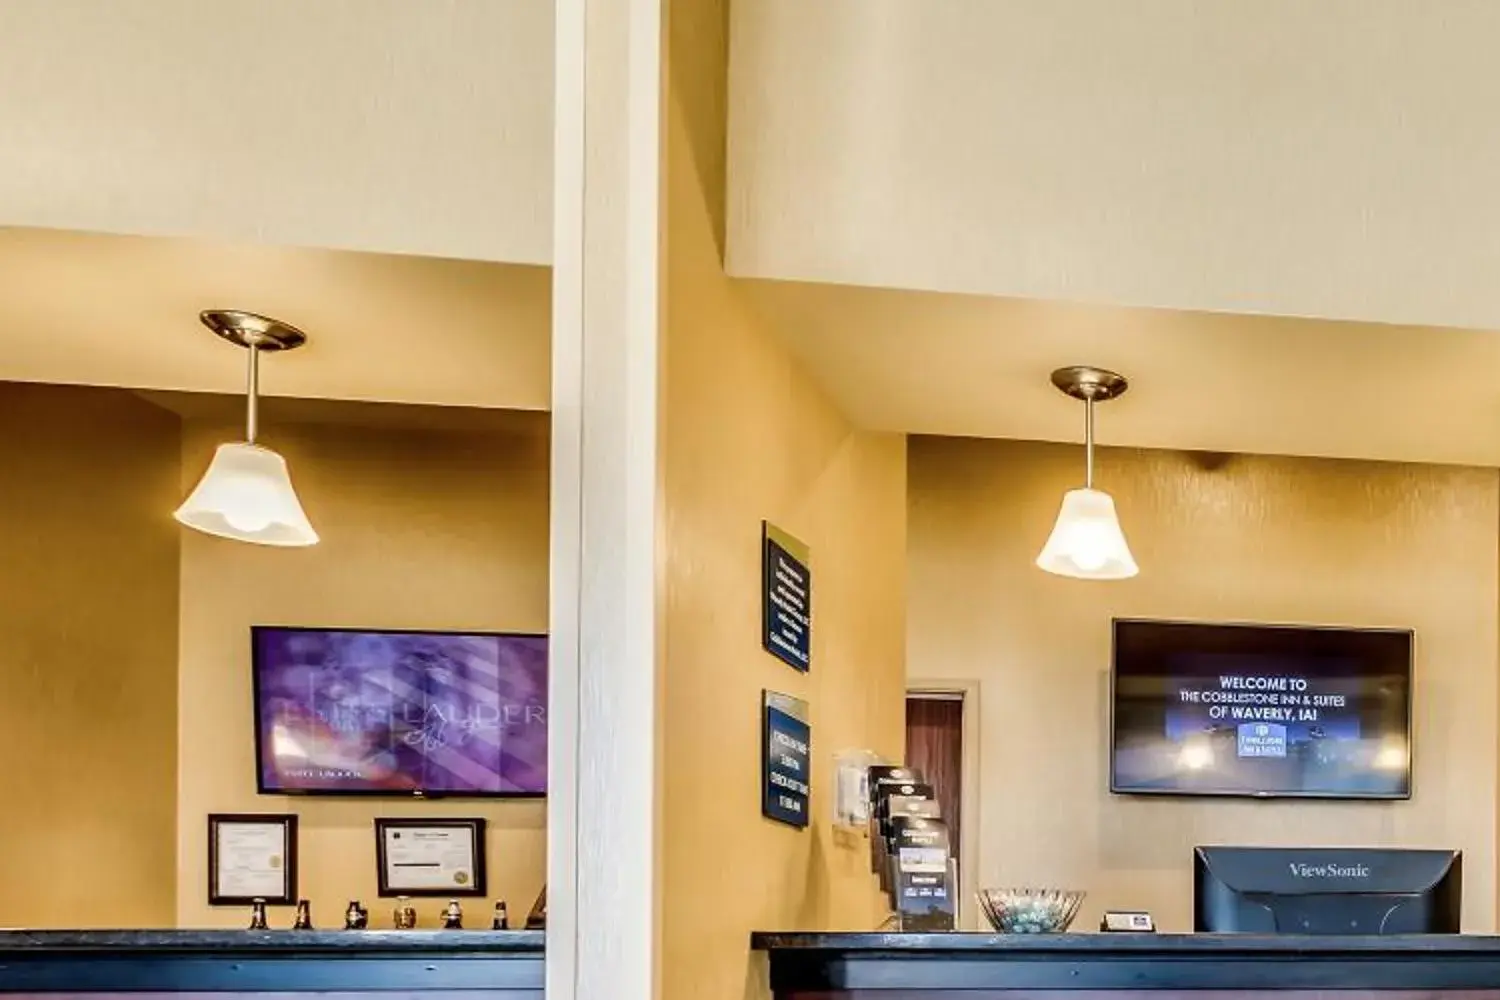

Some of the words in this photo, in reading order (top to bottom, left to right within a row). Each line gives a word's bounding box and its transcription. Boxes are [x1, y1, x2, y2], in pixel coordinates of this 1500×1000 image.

[1220, 676, 1286, 690] WELCOME
[1290, 679, 1307, 691] TO
[1180, 691, 1199, 702] THE
[1201, 691, 1279, 705] COBBLESTONE
[1282, 694, 1300, 704] INN
[1302, 696, 1310, 706] &
[1313, 695, 1345, 707] SUITES
[1209, 706, 1228, 719] OF
[1231, 707, 1295, 721] WAVERLY,
[1290, 863, 1369, 877] ViewSonic
